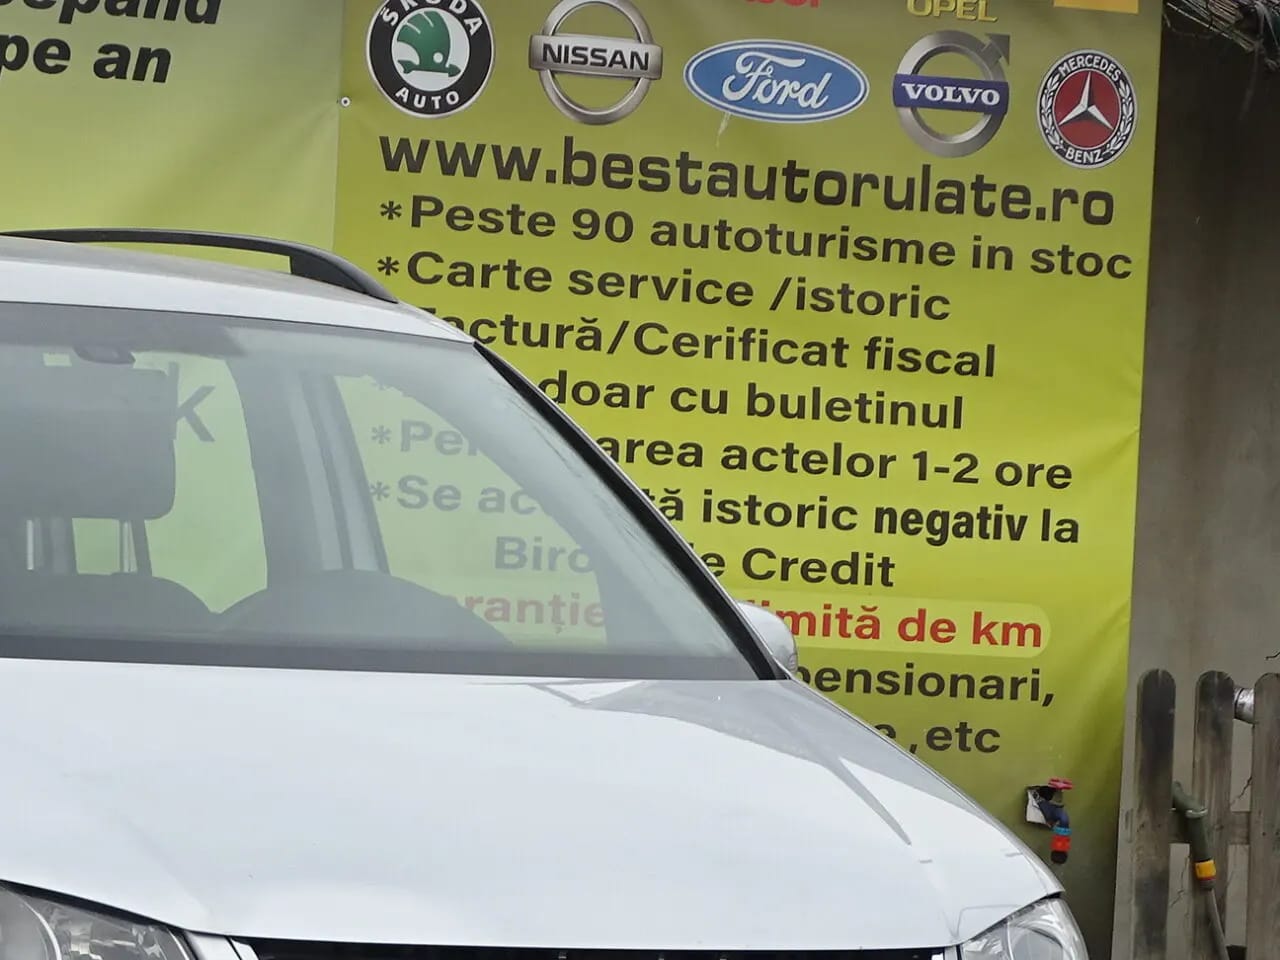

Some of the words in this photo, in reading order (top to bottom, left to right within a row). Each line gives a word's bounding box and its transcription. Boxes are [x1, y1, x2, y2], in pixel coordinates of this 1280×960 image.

[907, 0, 999, 21] OPEL
[93, 43, 171, 83] an
[542, 43, 650, 70] NISSAN
[1058, 54, 1121, 81] MERCEDES
[396, 87, 459, 109] AUTO
[722, 51, 833, 109] Ford
[902, 82, 1000, 106] VOLVO
[1065, 147, 1104, 163] BENZ
[379, 136, 1115, 226] www.bestautorulate.ro
[571, 208, 634, 243] 90
[650, 219, 956, 267] autoturisme
[971, 235, 1014, 270] in
[1030, 244, 1133, 279] stoc
[568, 268, 754, 307] service
[864, 336, 996, 377] fiscal
[538, 370, 655, 409] doar
[670, 387, 728, 415] cu
[746, 382, 964, 429] buletinul
[721, 442, 897, 479] actelor
[912, 450, 979, 484] 1-2
[994, 462, 1073, 489] ore
[702, 489, 858, 531] istoric
[874, 504, 1028, 546] negativ
[1041, 509, 1080, 543] la
[741, 548, 895, 587] Credit
[897, 608, 957, 642] de
[972, 611, 1041, 648] km
